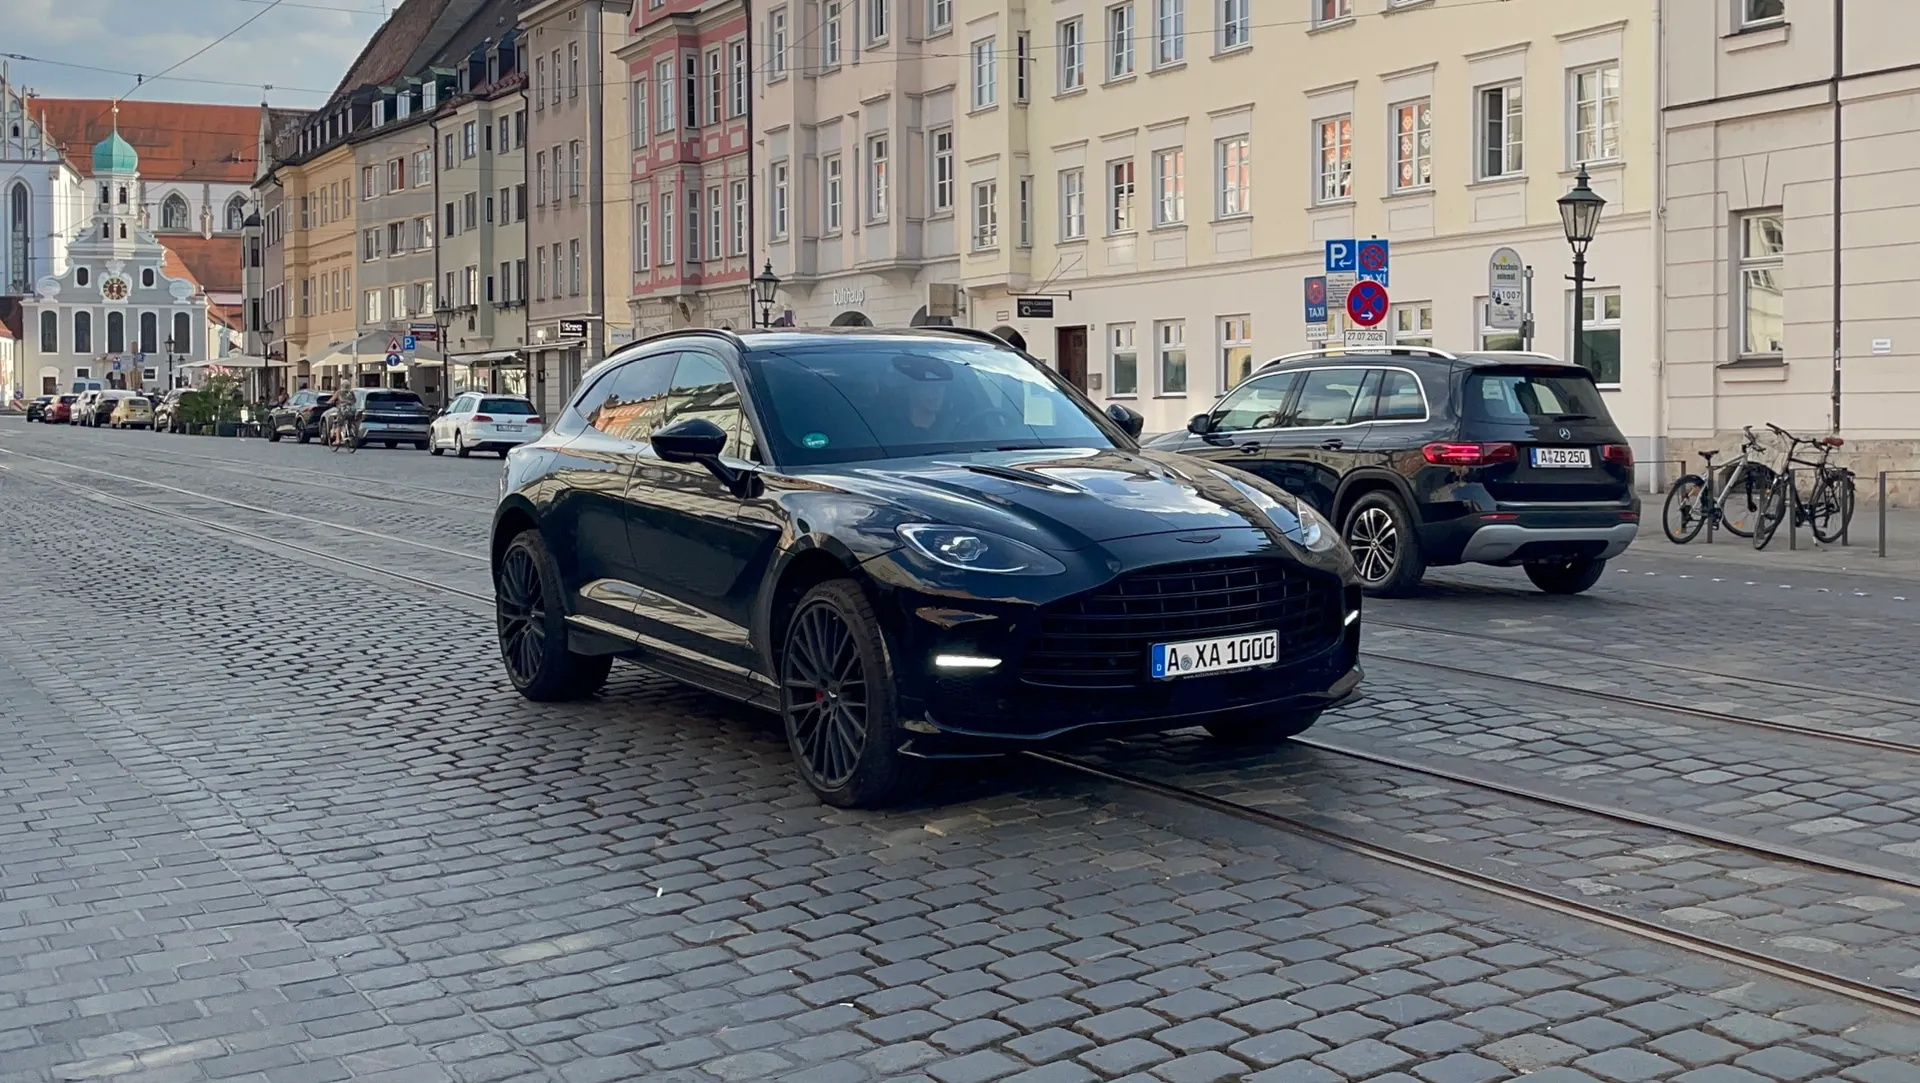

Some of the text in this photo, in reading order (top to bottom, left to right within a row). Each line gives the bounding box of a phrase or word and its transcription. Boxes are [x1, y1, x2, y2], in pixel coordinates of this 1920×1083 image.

[1330, 243, 1347, 268] P
[833, 287, 866, 308] bulthaup
[1308, 306, 1325, 318] TAXI
[404, 338, 412, 349] P
[1541, 450, 1586, 463] A ZB 250
[1167, 636, 1276, 672] A XA 1000
